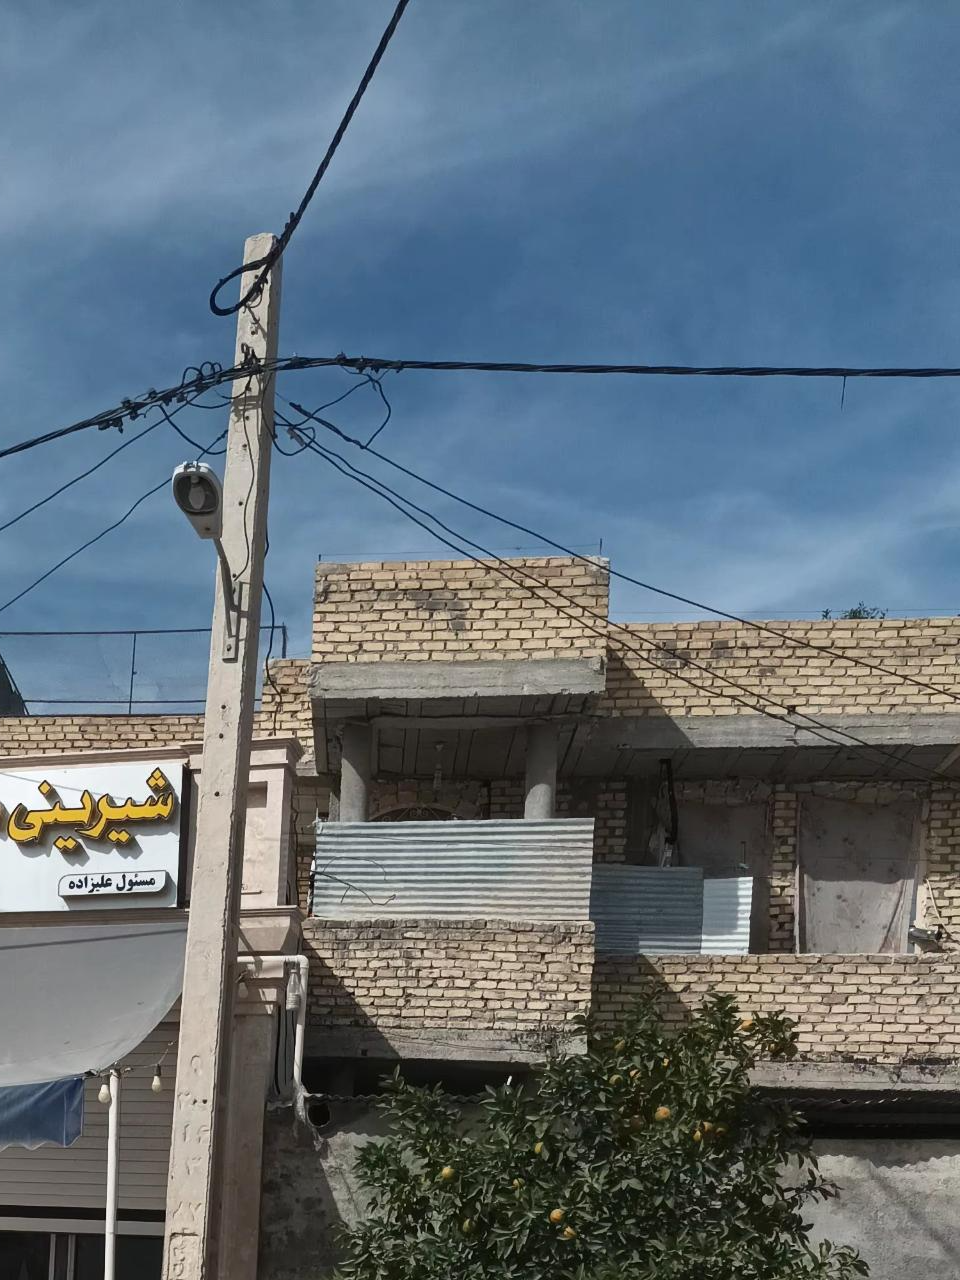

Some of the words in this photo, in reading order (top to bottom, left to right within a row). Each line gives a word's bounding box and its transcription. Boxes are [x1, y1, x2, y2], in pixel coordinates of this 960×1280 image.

[7, 767, 174, 850] شیرینی
[68, 875, 112, 893] علیزاده
[116, 873, 156, 891] مسئول
